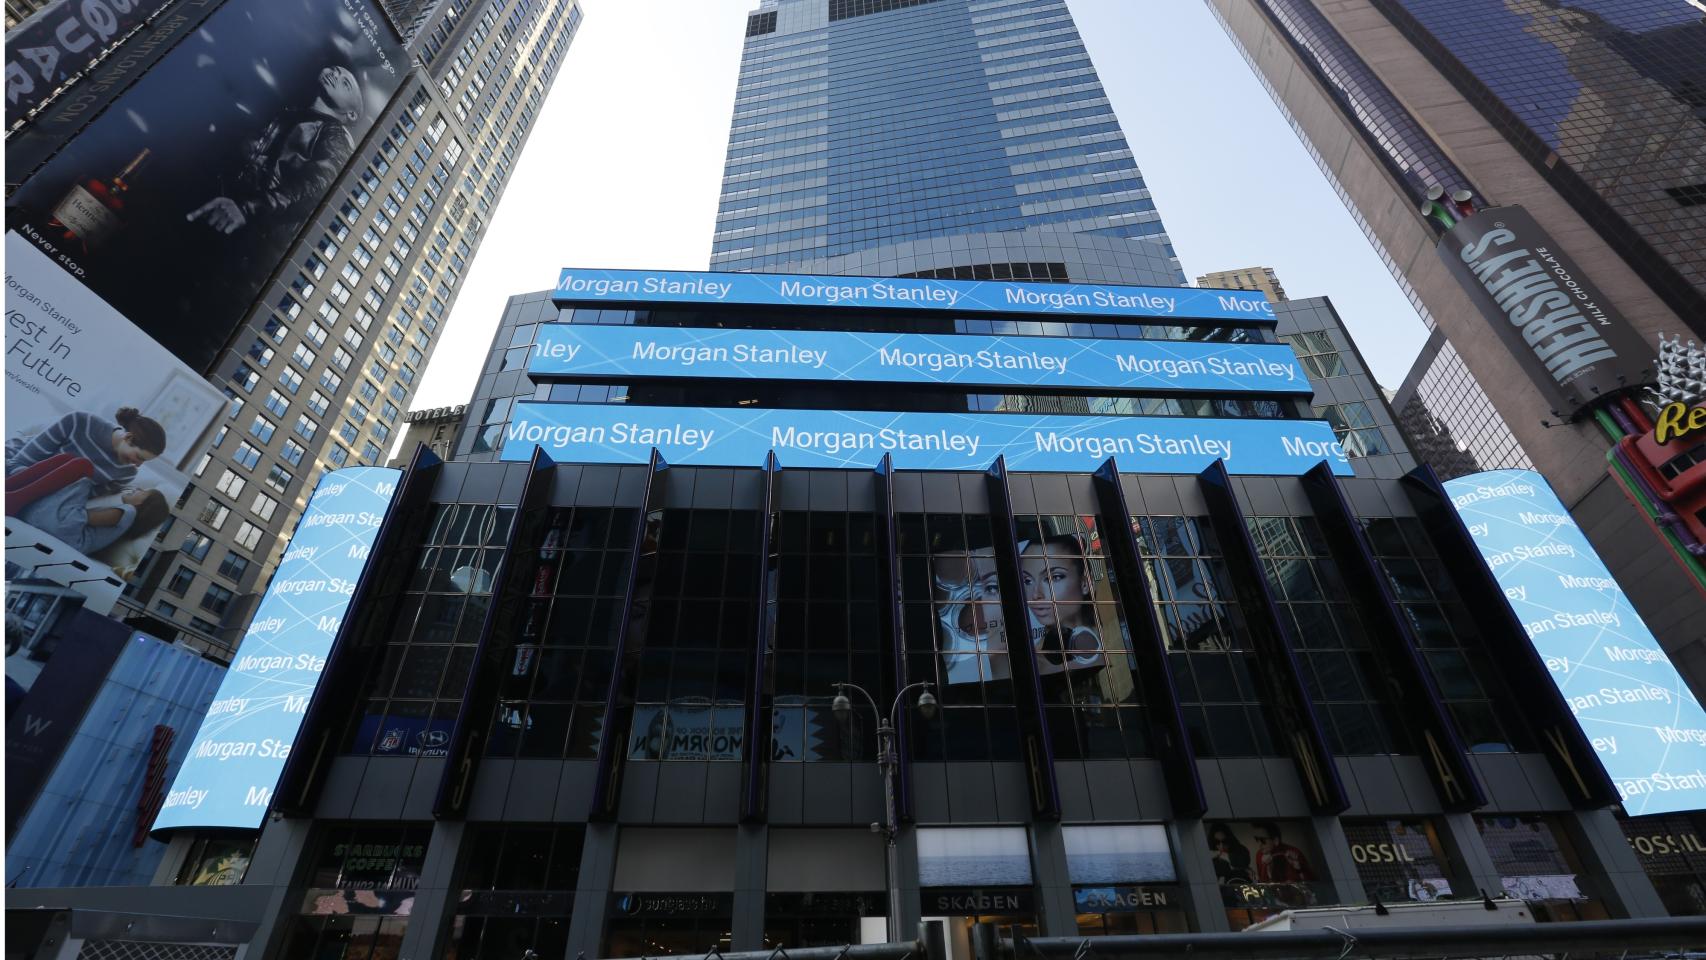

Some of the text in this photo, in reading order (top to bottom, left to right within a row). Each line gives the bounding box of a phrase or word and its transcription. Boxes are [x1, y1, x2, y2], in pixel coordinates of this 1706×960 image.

[21, 223, 59, 254] Never
[58, 254, 86, 279] stop.
[643, 277, 733, 300] Stanley
[780, 280, 959, 306] Morgan Stanley
[1536, 246, 1611, 326] MILK CHOCOLATE
[1005, 287, 1176, 312] Morgan Stanley
[1460, 228, 1618, 381] HERSHEY'S
[41, 302, 82, 335] Stanley
[48, 335, 71, 360] In
[632, 341, 828, 368] Morgan Stanley
[7, 338, 82, 398] Future
[879, 347, 1068, 375] Morgan Stanley
[1116, 353, 1295, 381] Morgan Stanley
[405, 406, 449, 422] HOTEL
[609, 422, 715, 451] Stanley
[771, 425, 981, 456] Morgan Stanley
[1034, 431, 1232, 460] Morgan Stanley
[1476, 483, 1535, 500] Stanley
[304, 513, 355, 529] Morgan
[1512, 542, 1576, 560] Stanley
[272, 578, 326, 597] Morgan
[1553, 609, 1621, 628] Stanley
[236, 655, 293, 673] Morgan
[1599, 684, 1672, 705] Stanley
[196, 739, 257, 760] Morgan
[1592, 736, 1618, 754] ey
[938, 895, 1019, 911] SKAGEN
[1087, 891, 1168, 908] SKAGEN
